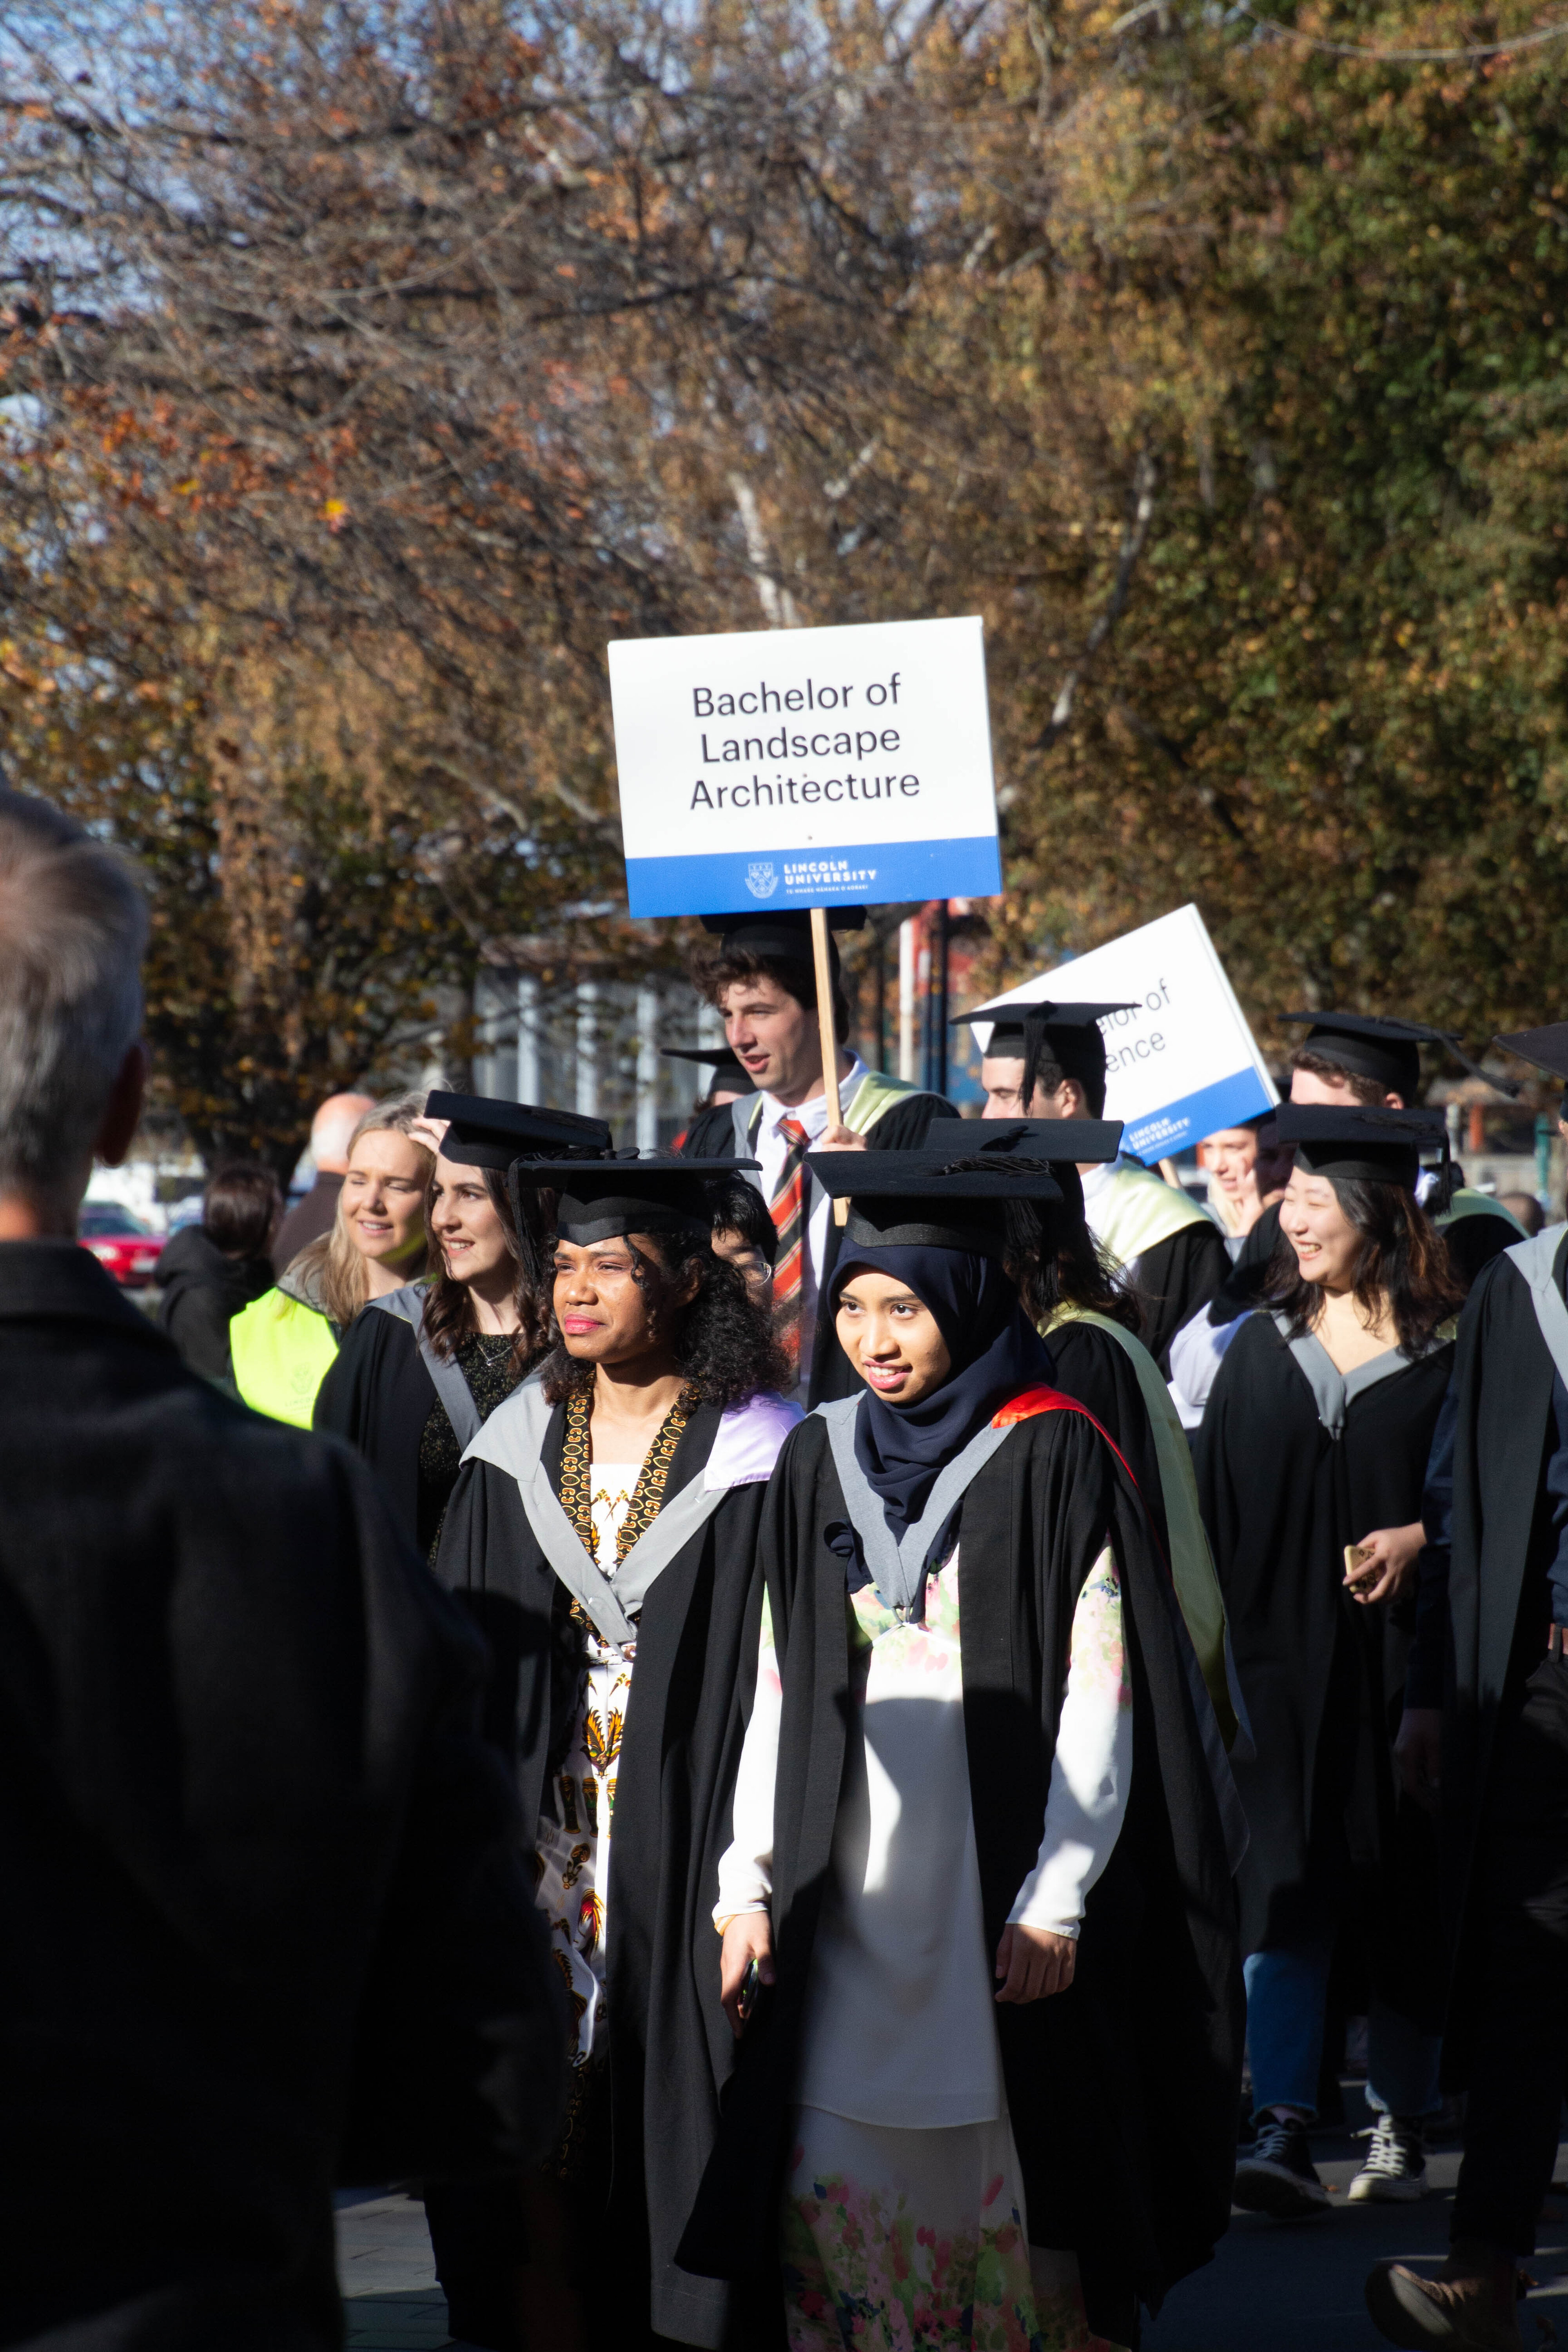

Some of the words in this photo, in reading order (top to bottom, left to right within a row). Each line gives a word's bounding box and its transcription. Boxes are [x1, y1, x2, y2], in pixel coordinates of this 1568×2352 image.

[693, 678, 854, 717] Bachelor
[866, 672, 901, 706] of
[701, 726, 900, 763] Landscape
[690, 773, 920, 810] Architecture
[784, 860, 848, 875] LINCOLN
[785, 869, 877, 885] UNIVERSITY
[1146, 978, 1170, 1011] of
[1105, 1033, 1166, 1073] ence
